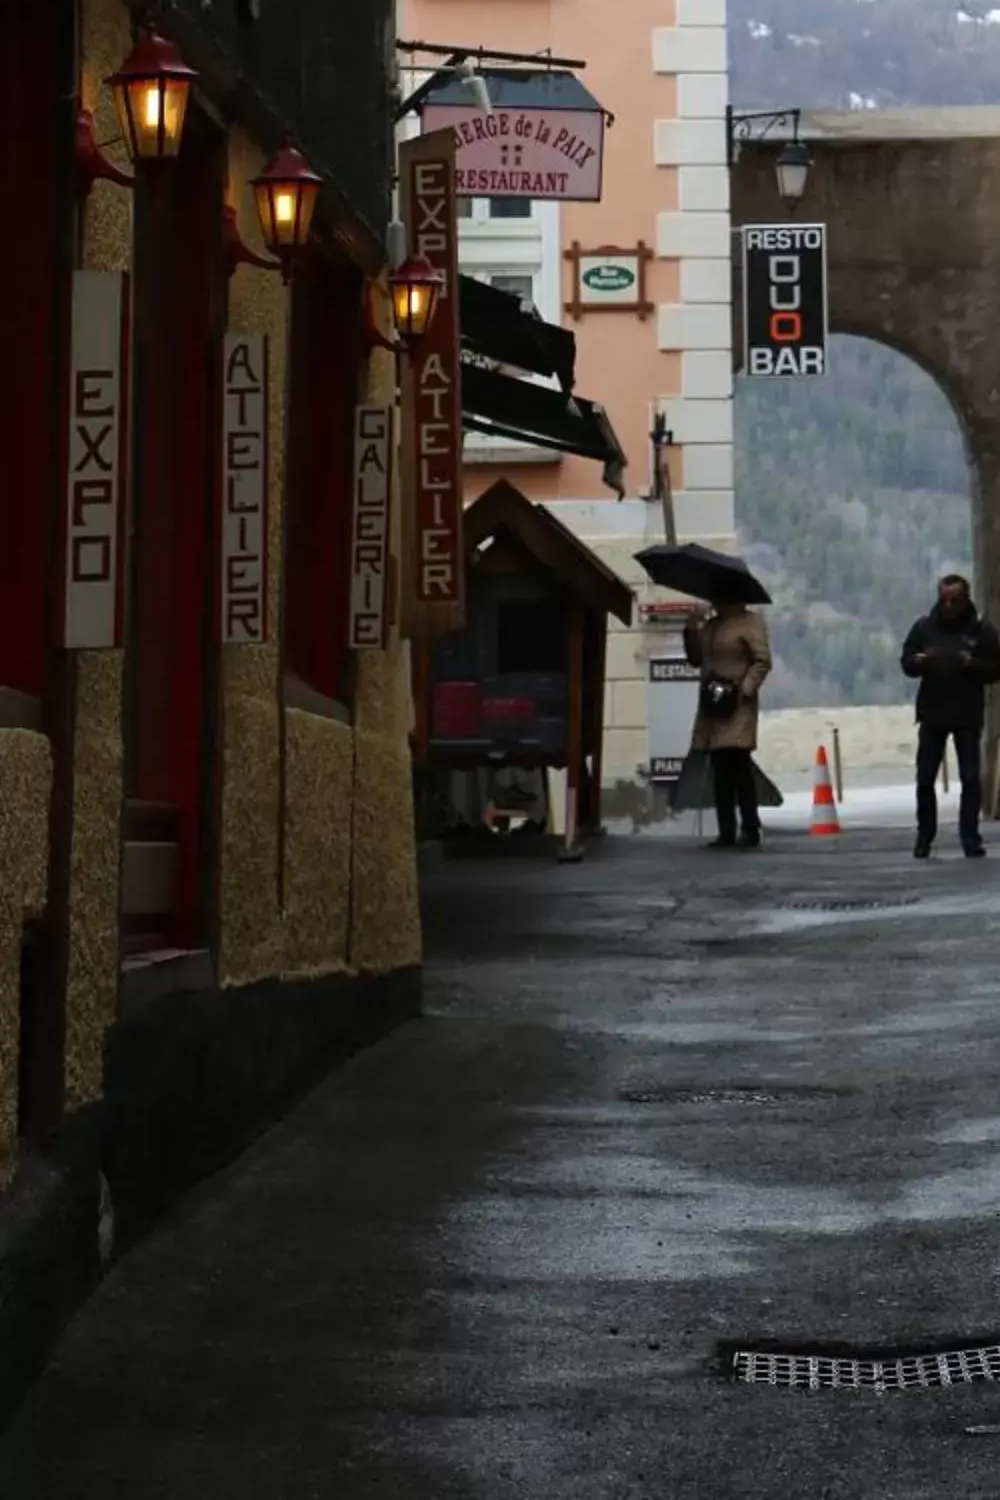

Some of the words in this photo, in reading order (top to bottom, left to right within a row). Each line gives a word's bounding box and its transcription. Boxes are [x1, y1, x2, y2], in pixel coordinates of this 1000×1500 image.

[455, 168, 569, 193] RESTAURANT
[514, 113, 533, 138] de
[535, 118, 552, 145] la
[551, 127, 597, 170] PAIX
[747, 229, 822, 250] RESTO
[769, 254, 801, 341] DUO
[750, 346, 824, 375] BAR
[71, 369, 114, 583] EXPO
[226, 343, 260, 640] ATELIER
[419, 353, 454, 597] ATELIER
[353, 408, 387, 645] GALERIE
